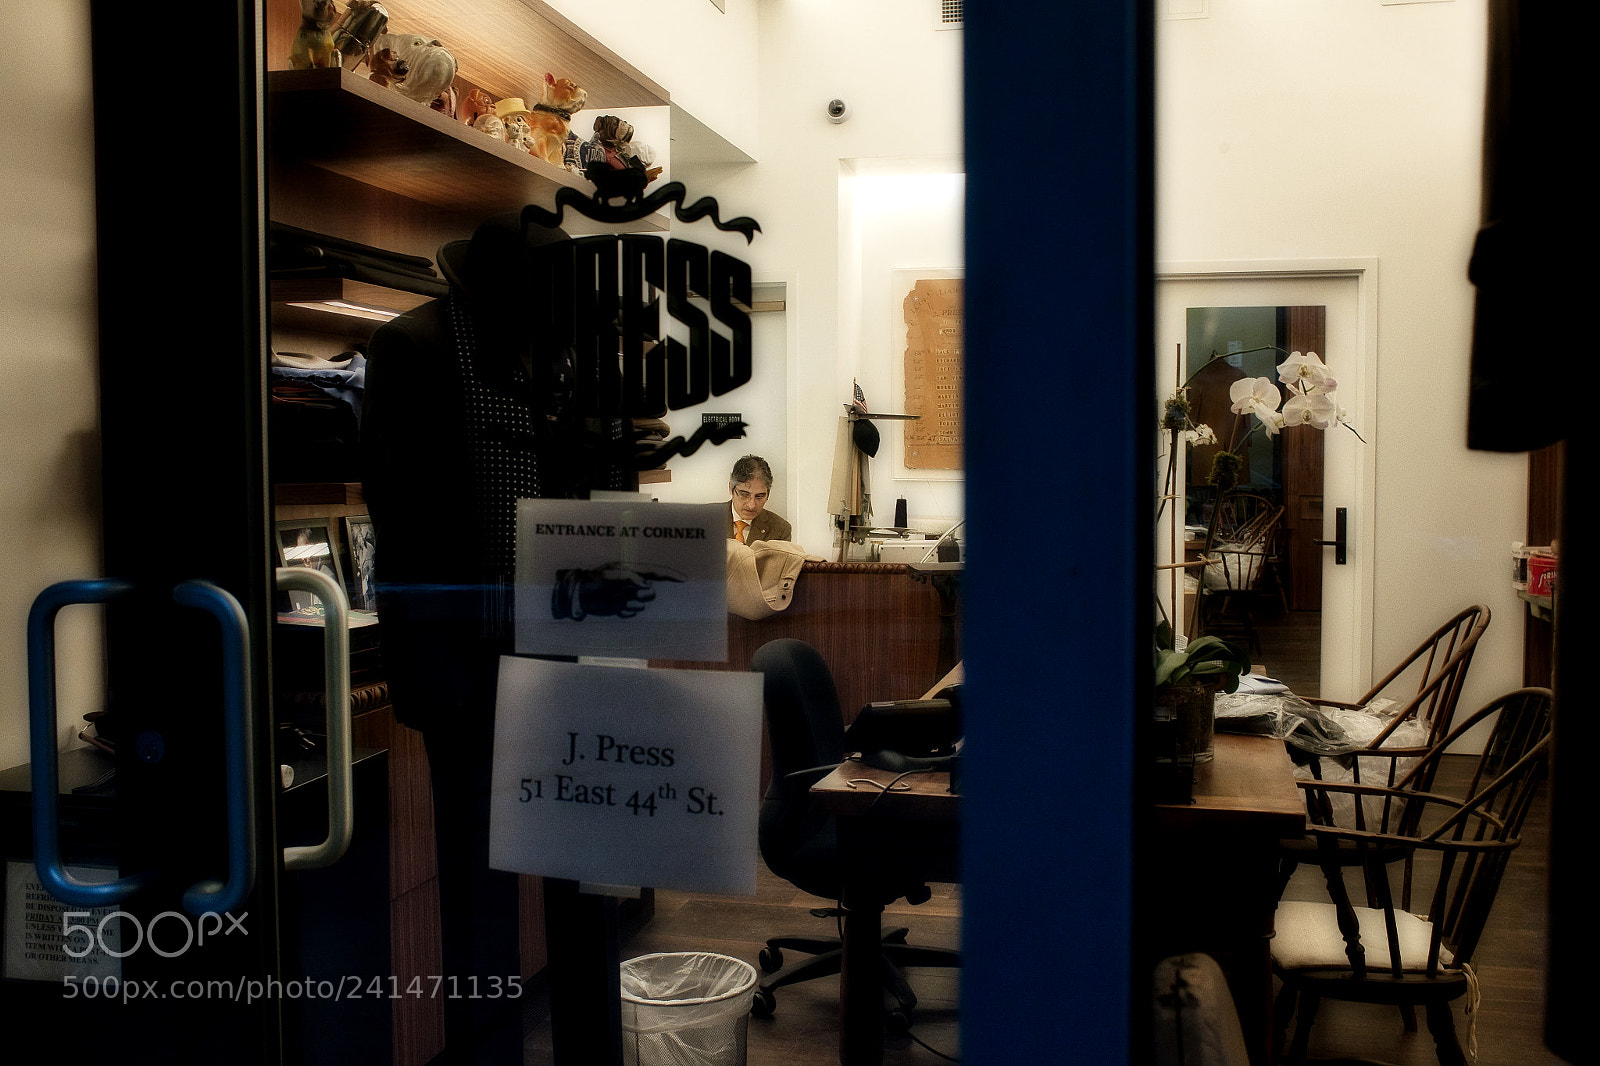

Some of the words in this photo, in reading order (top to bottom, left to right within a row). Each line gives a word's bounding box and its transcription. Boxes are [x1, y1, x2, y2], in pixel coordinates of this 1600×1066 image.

[535, 524, 615, 538] ENTRANCE
[620, 525, 640, 538] AT
[643, 526, 706, 539] CORNER
[562, 732, 586, 766] J.
[595, 734, 675, 768] Press
[519, 777, 543, 803] 51
[554, 774, 616, 806] East
[625, 783, 677, 817] 44th
[686, 787, 724, 816] St.
[25, 912, 55, 921] FRIDAY
[25, 923, 56, 931] UNLESS
[25, 942, 46, 950] ITEM
[39, 953, 67, 962] OTHER
